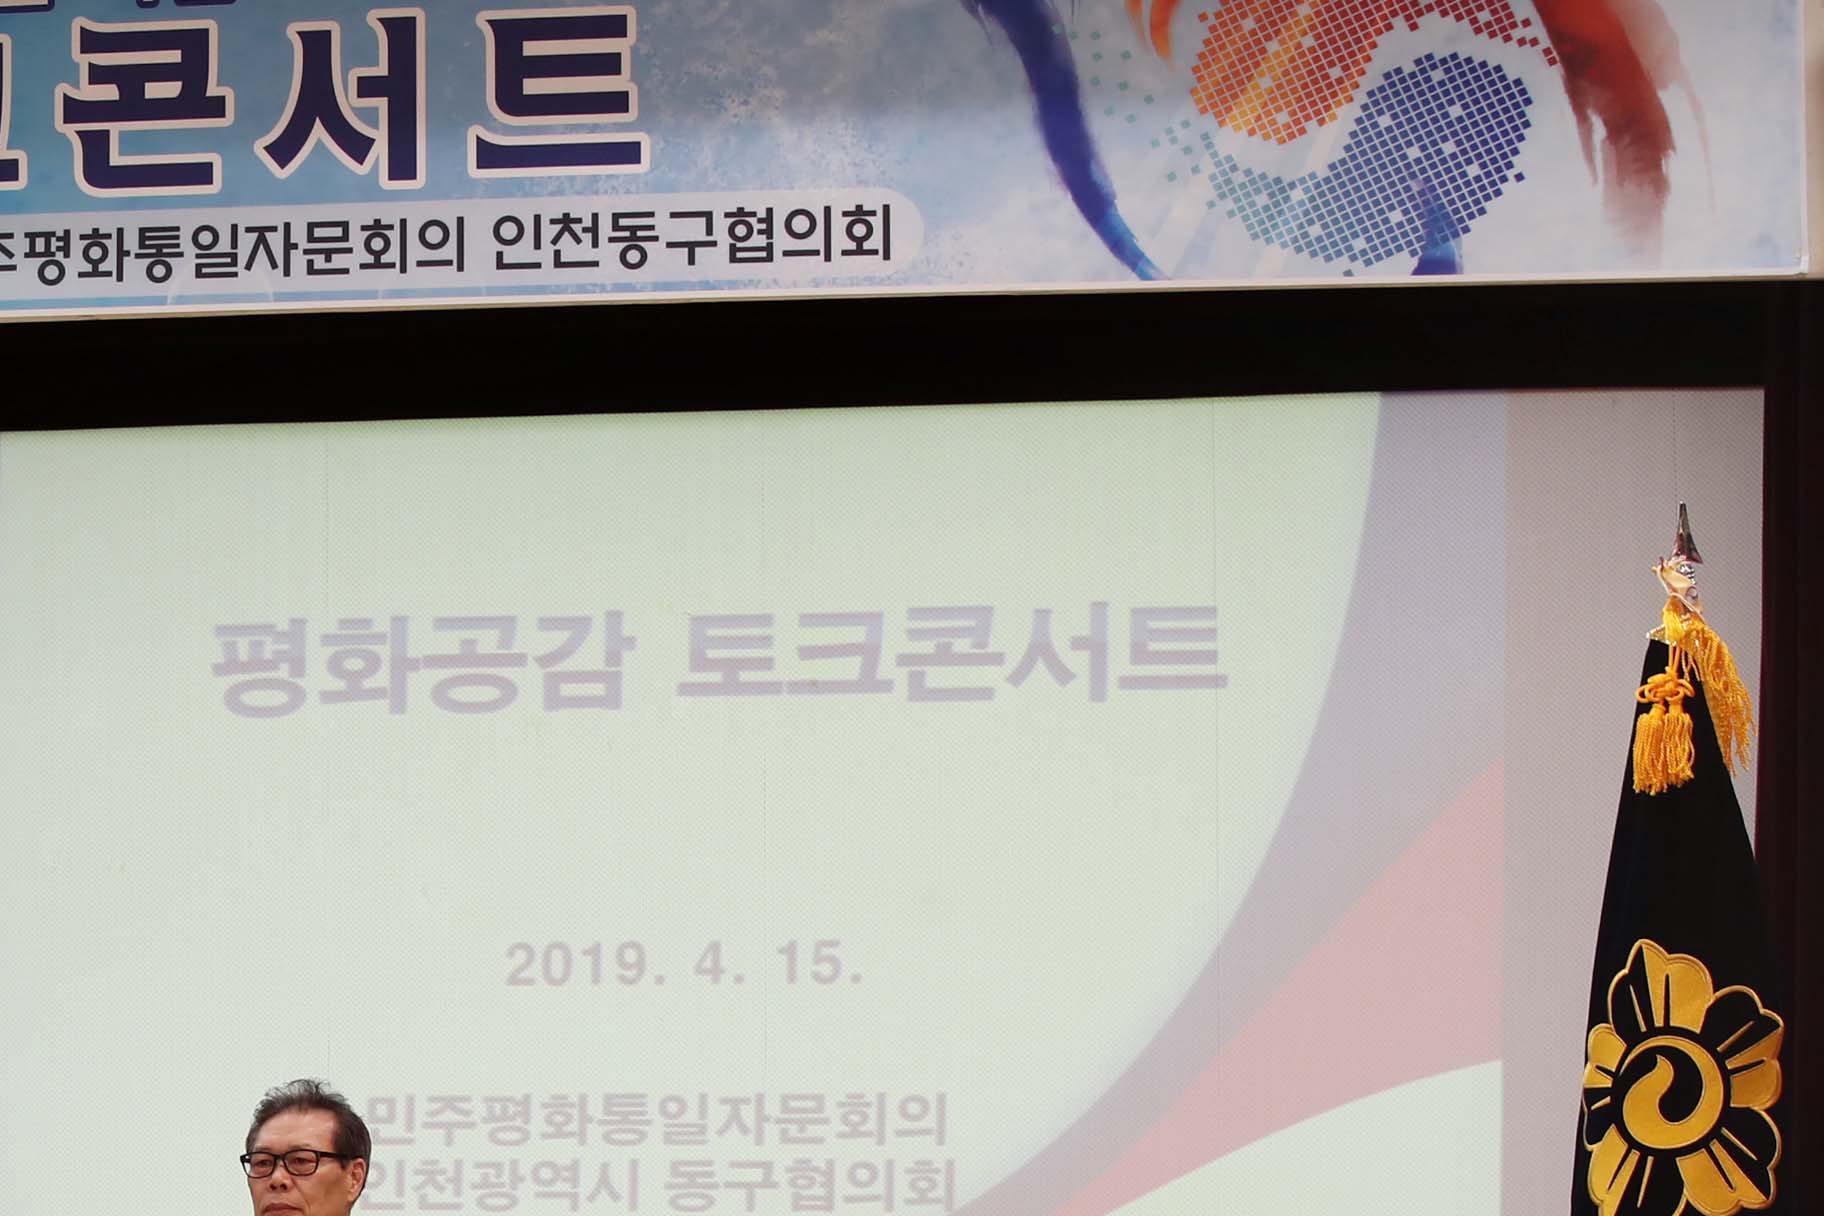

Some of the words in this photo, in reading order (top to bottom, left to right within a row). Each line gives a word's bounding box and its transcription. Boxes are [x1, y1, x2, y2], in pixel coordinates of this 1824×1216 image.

[492, 203, 891, 270] 인천동구협의회
[210, 609, 639, 719] 평화공감
[677, 600, 1229, 704] 토크콘서트
[505, 940, 666, 987] 2019.
[693, 939, 746, 985] 4.
[777, 938, 863, 985] 15.
[367, 1091, 950, 1147] 민주평화통일자문회의
[361, 1157, 640, 1213] 인천광역시
[663, 1157, 956, 1213] 동구협의회
